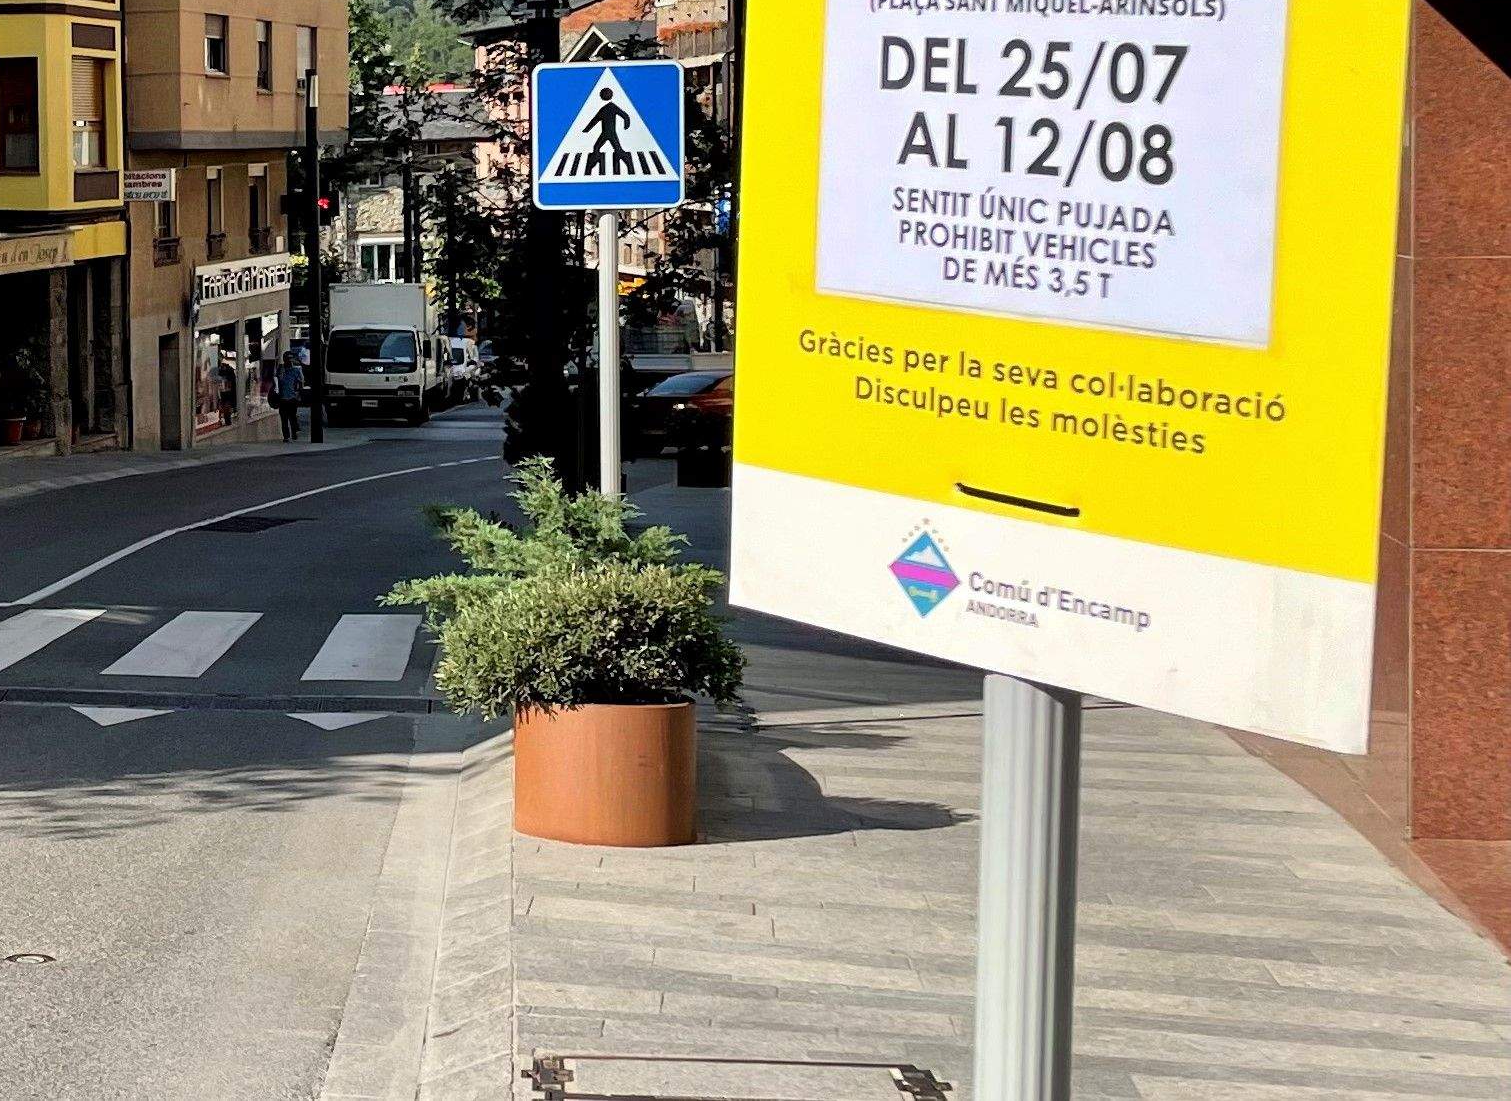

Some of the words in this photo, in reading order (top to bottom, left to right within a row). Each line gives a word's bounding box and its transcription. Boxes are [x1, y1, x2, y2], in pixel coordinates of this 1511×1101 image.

[879, 35, 978, 94] DEL
[998, 38, 1190, 110] 25/07
[897, 111, 968, 170] AL
[994, 116, 1176, 187] 12/08
[892, 186, 972, 219] SENTIT
[979, 186, 1047, 225] ÚNIC
[1057, 201, 1176, 237] PUJADA
[898, 220, 1014, 255] PROHIBIT
[1022, 233, 1156, 270] VEHICLES
[943, 256, 977, 283] DE
[984, 255, 1039, 290] MÉS
[1048, 266, 1089, 299] 3,5
[1097, 273, 1114, 298] T
[799, 328, 894, 367] Gràcies
[902, 348, 951, 378] per
[959, 350, 982, 378] la
[992, 363, 1059, 391] seva
[1069, 371, 1287, 423] col·laboració
[854, 376, 990, 420] Disculpeu
[1000, 397, 1040, 429] les
[1051, 411, 1207, 455] molèsties
[966, 600, 1040, 629] ANDORRA
[968, 571, 1032, 604] Comú
[1037, 586, 1152, 632] d'Encamp
